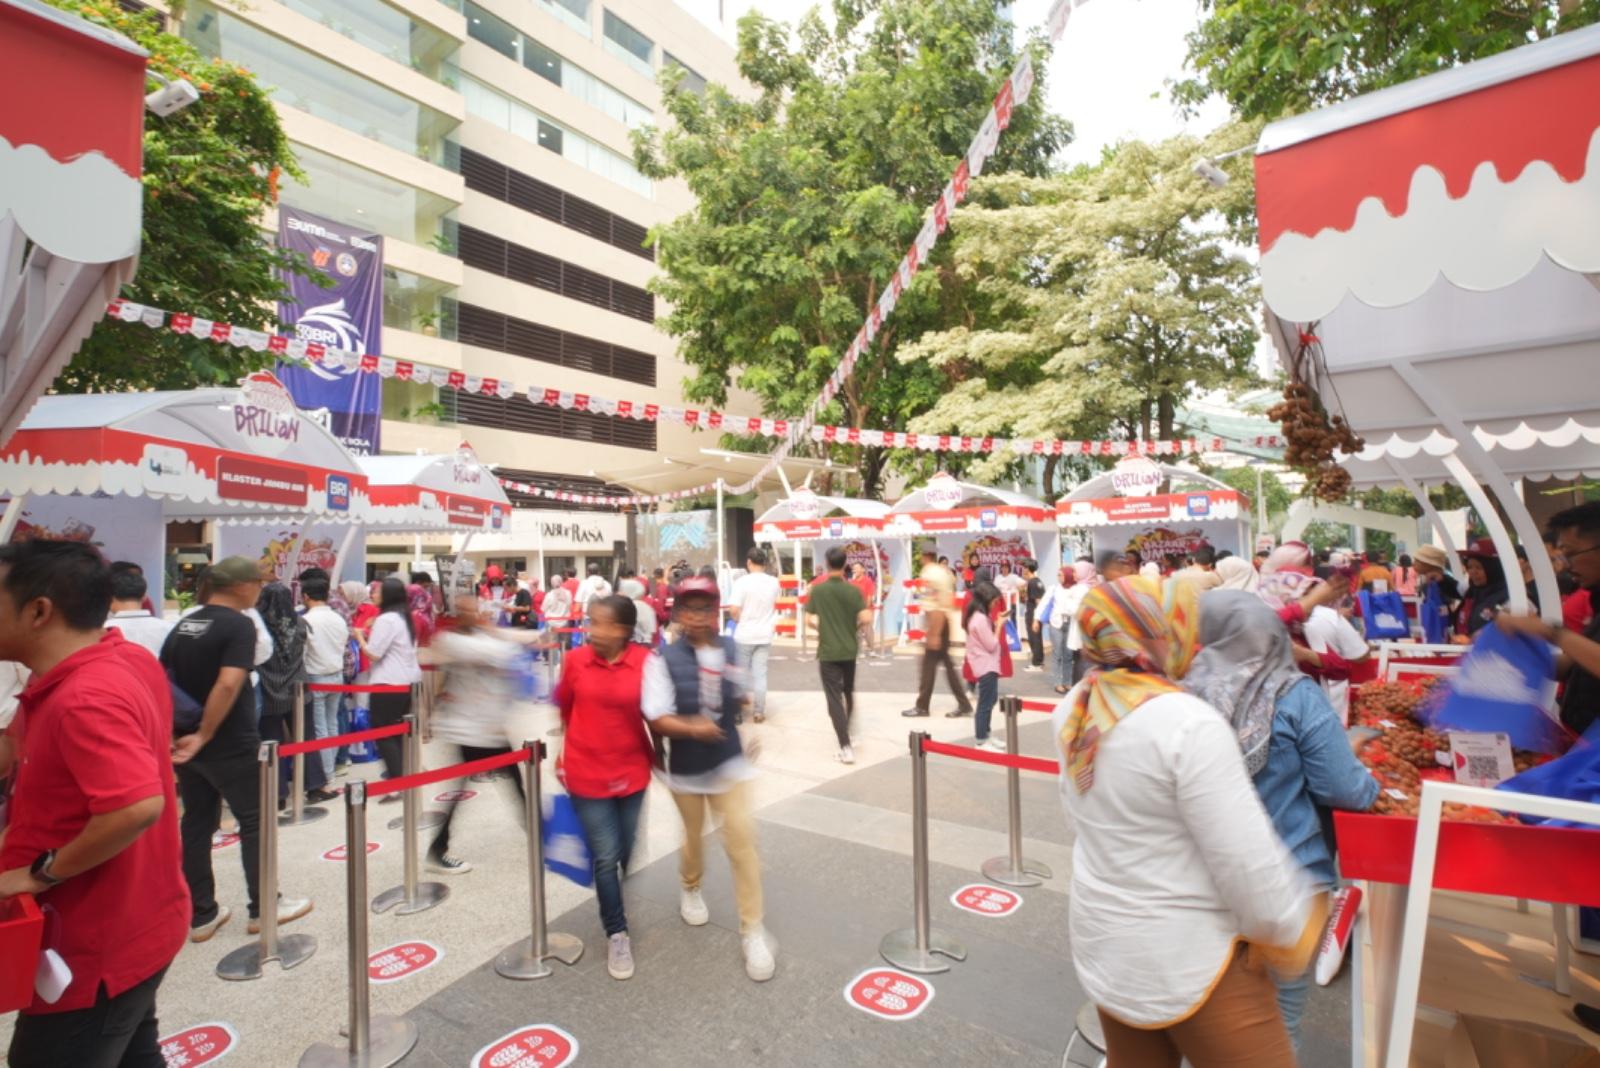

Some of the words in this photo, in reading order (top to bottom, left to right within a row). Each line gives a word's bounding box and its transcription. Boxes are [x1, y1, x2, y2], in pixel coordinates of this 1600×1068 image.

[221, 471, 262, 486] KLASTER
[330, 481, 348, 497] BRI
[571, 522, 604, 543] RASA
